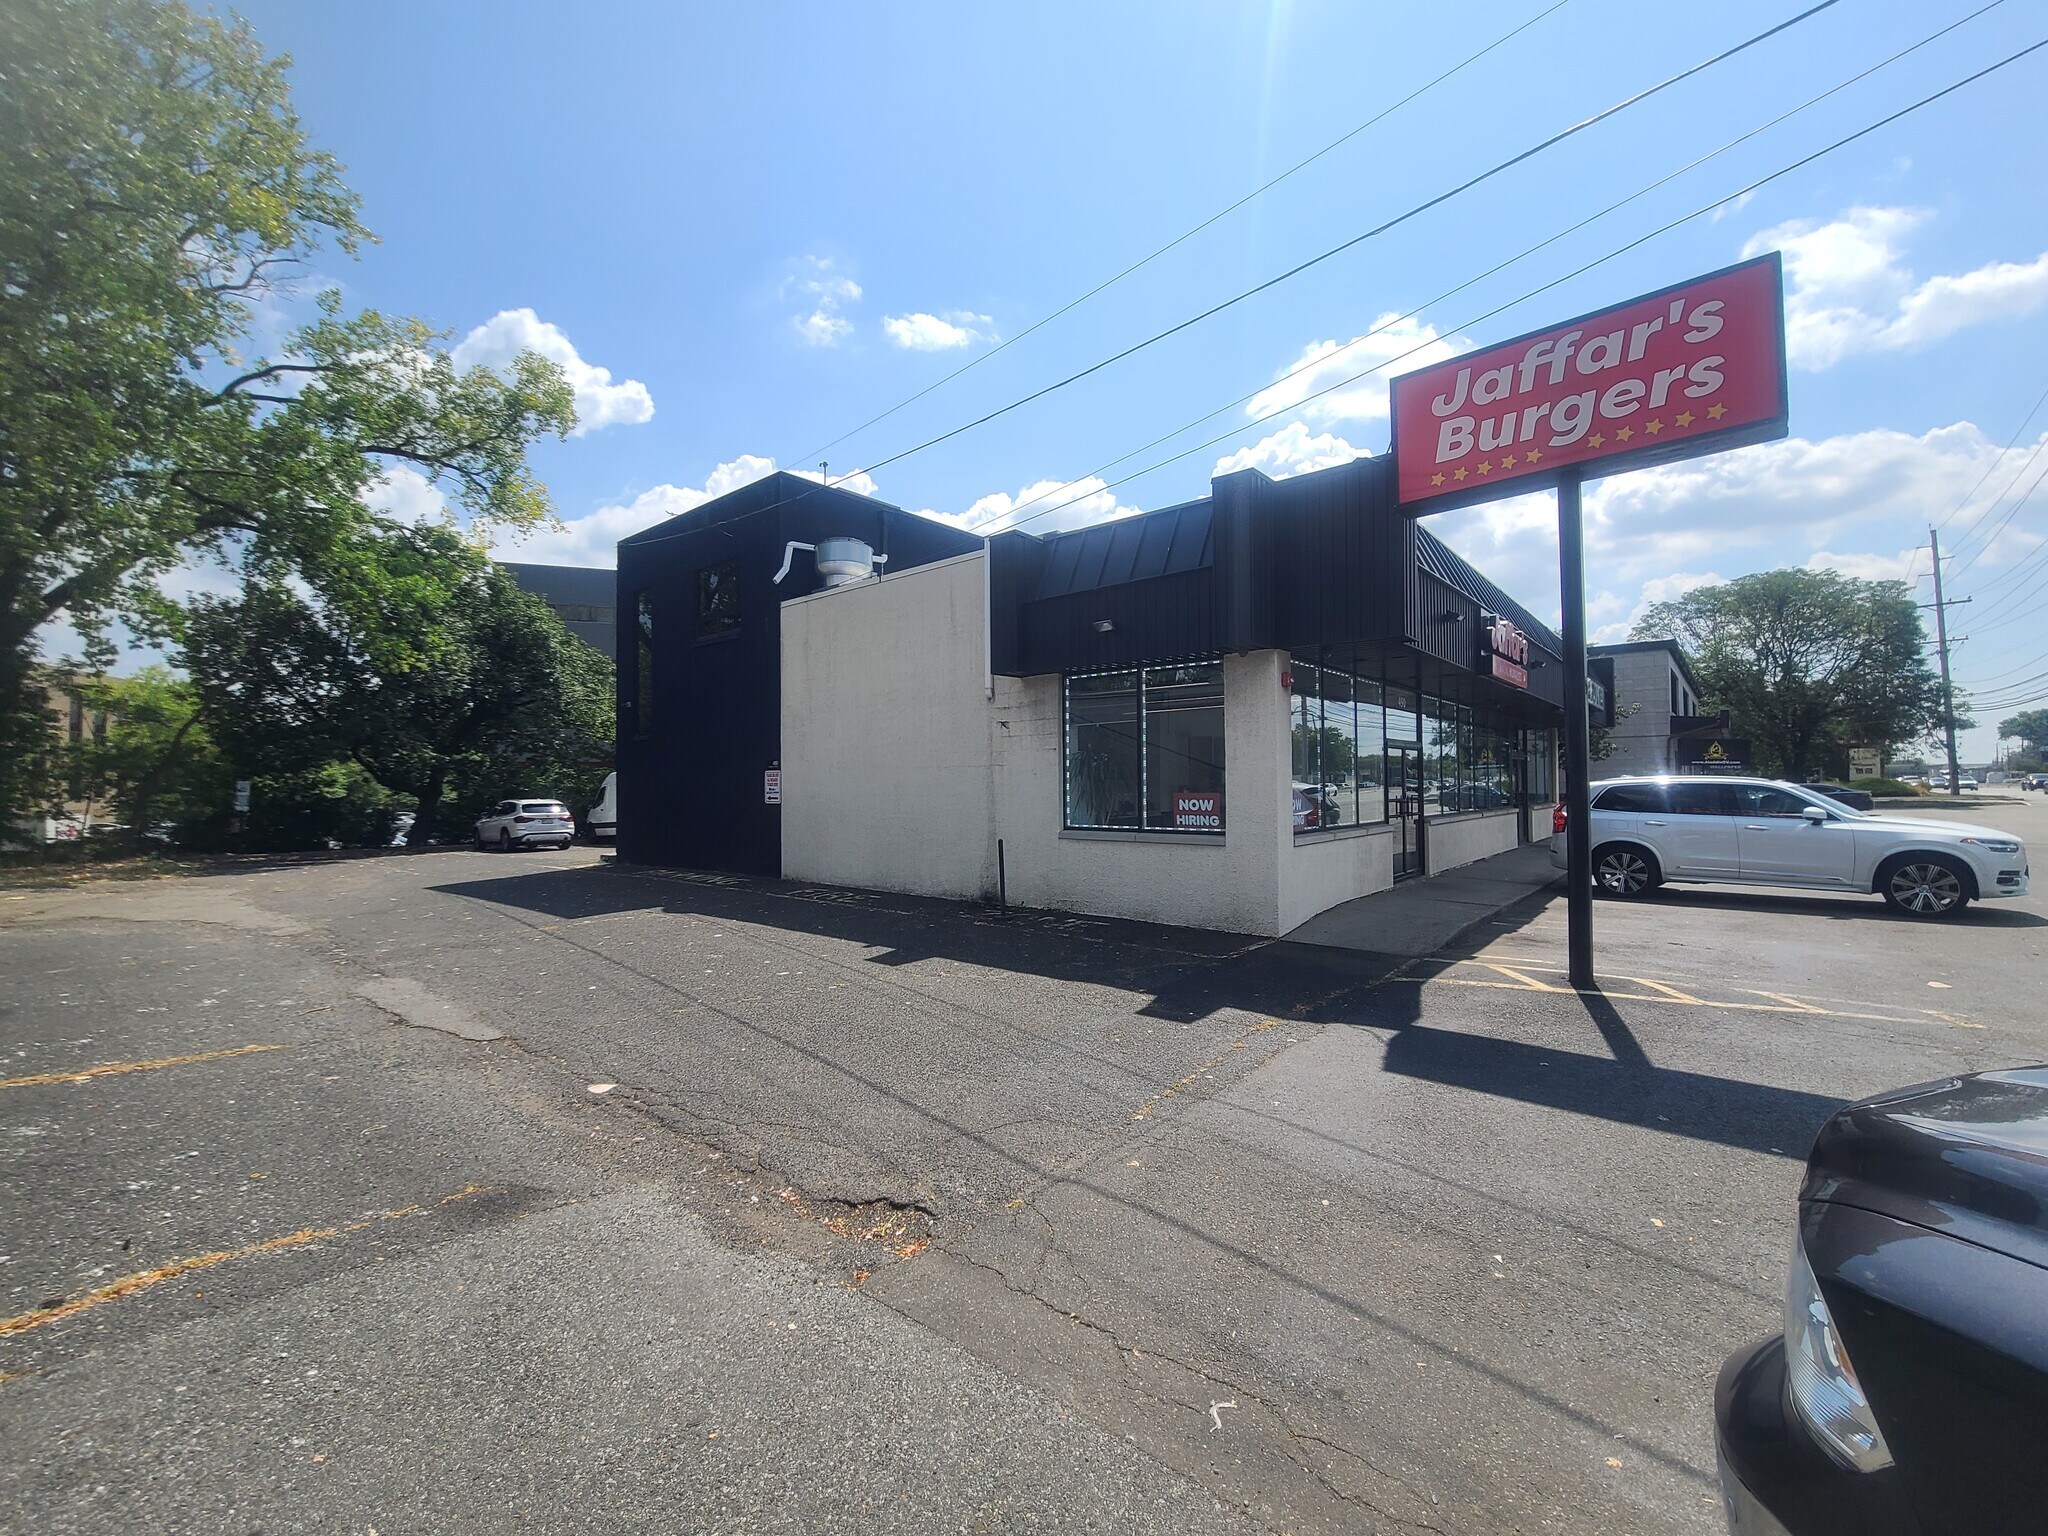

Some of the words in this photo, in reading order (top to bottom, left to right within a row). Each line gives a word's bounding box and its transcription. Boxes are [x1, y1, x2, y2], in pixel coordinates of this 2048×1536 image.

[1431, 298, 1725, 418] Jaffar's
[1434, 355, 1726, 464] Burgers
[1176, 814, 1220, 827] HIRING
[1178, 799, 1214, 812] NOW
